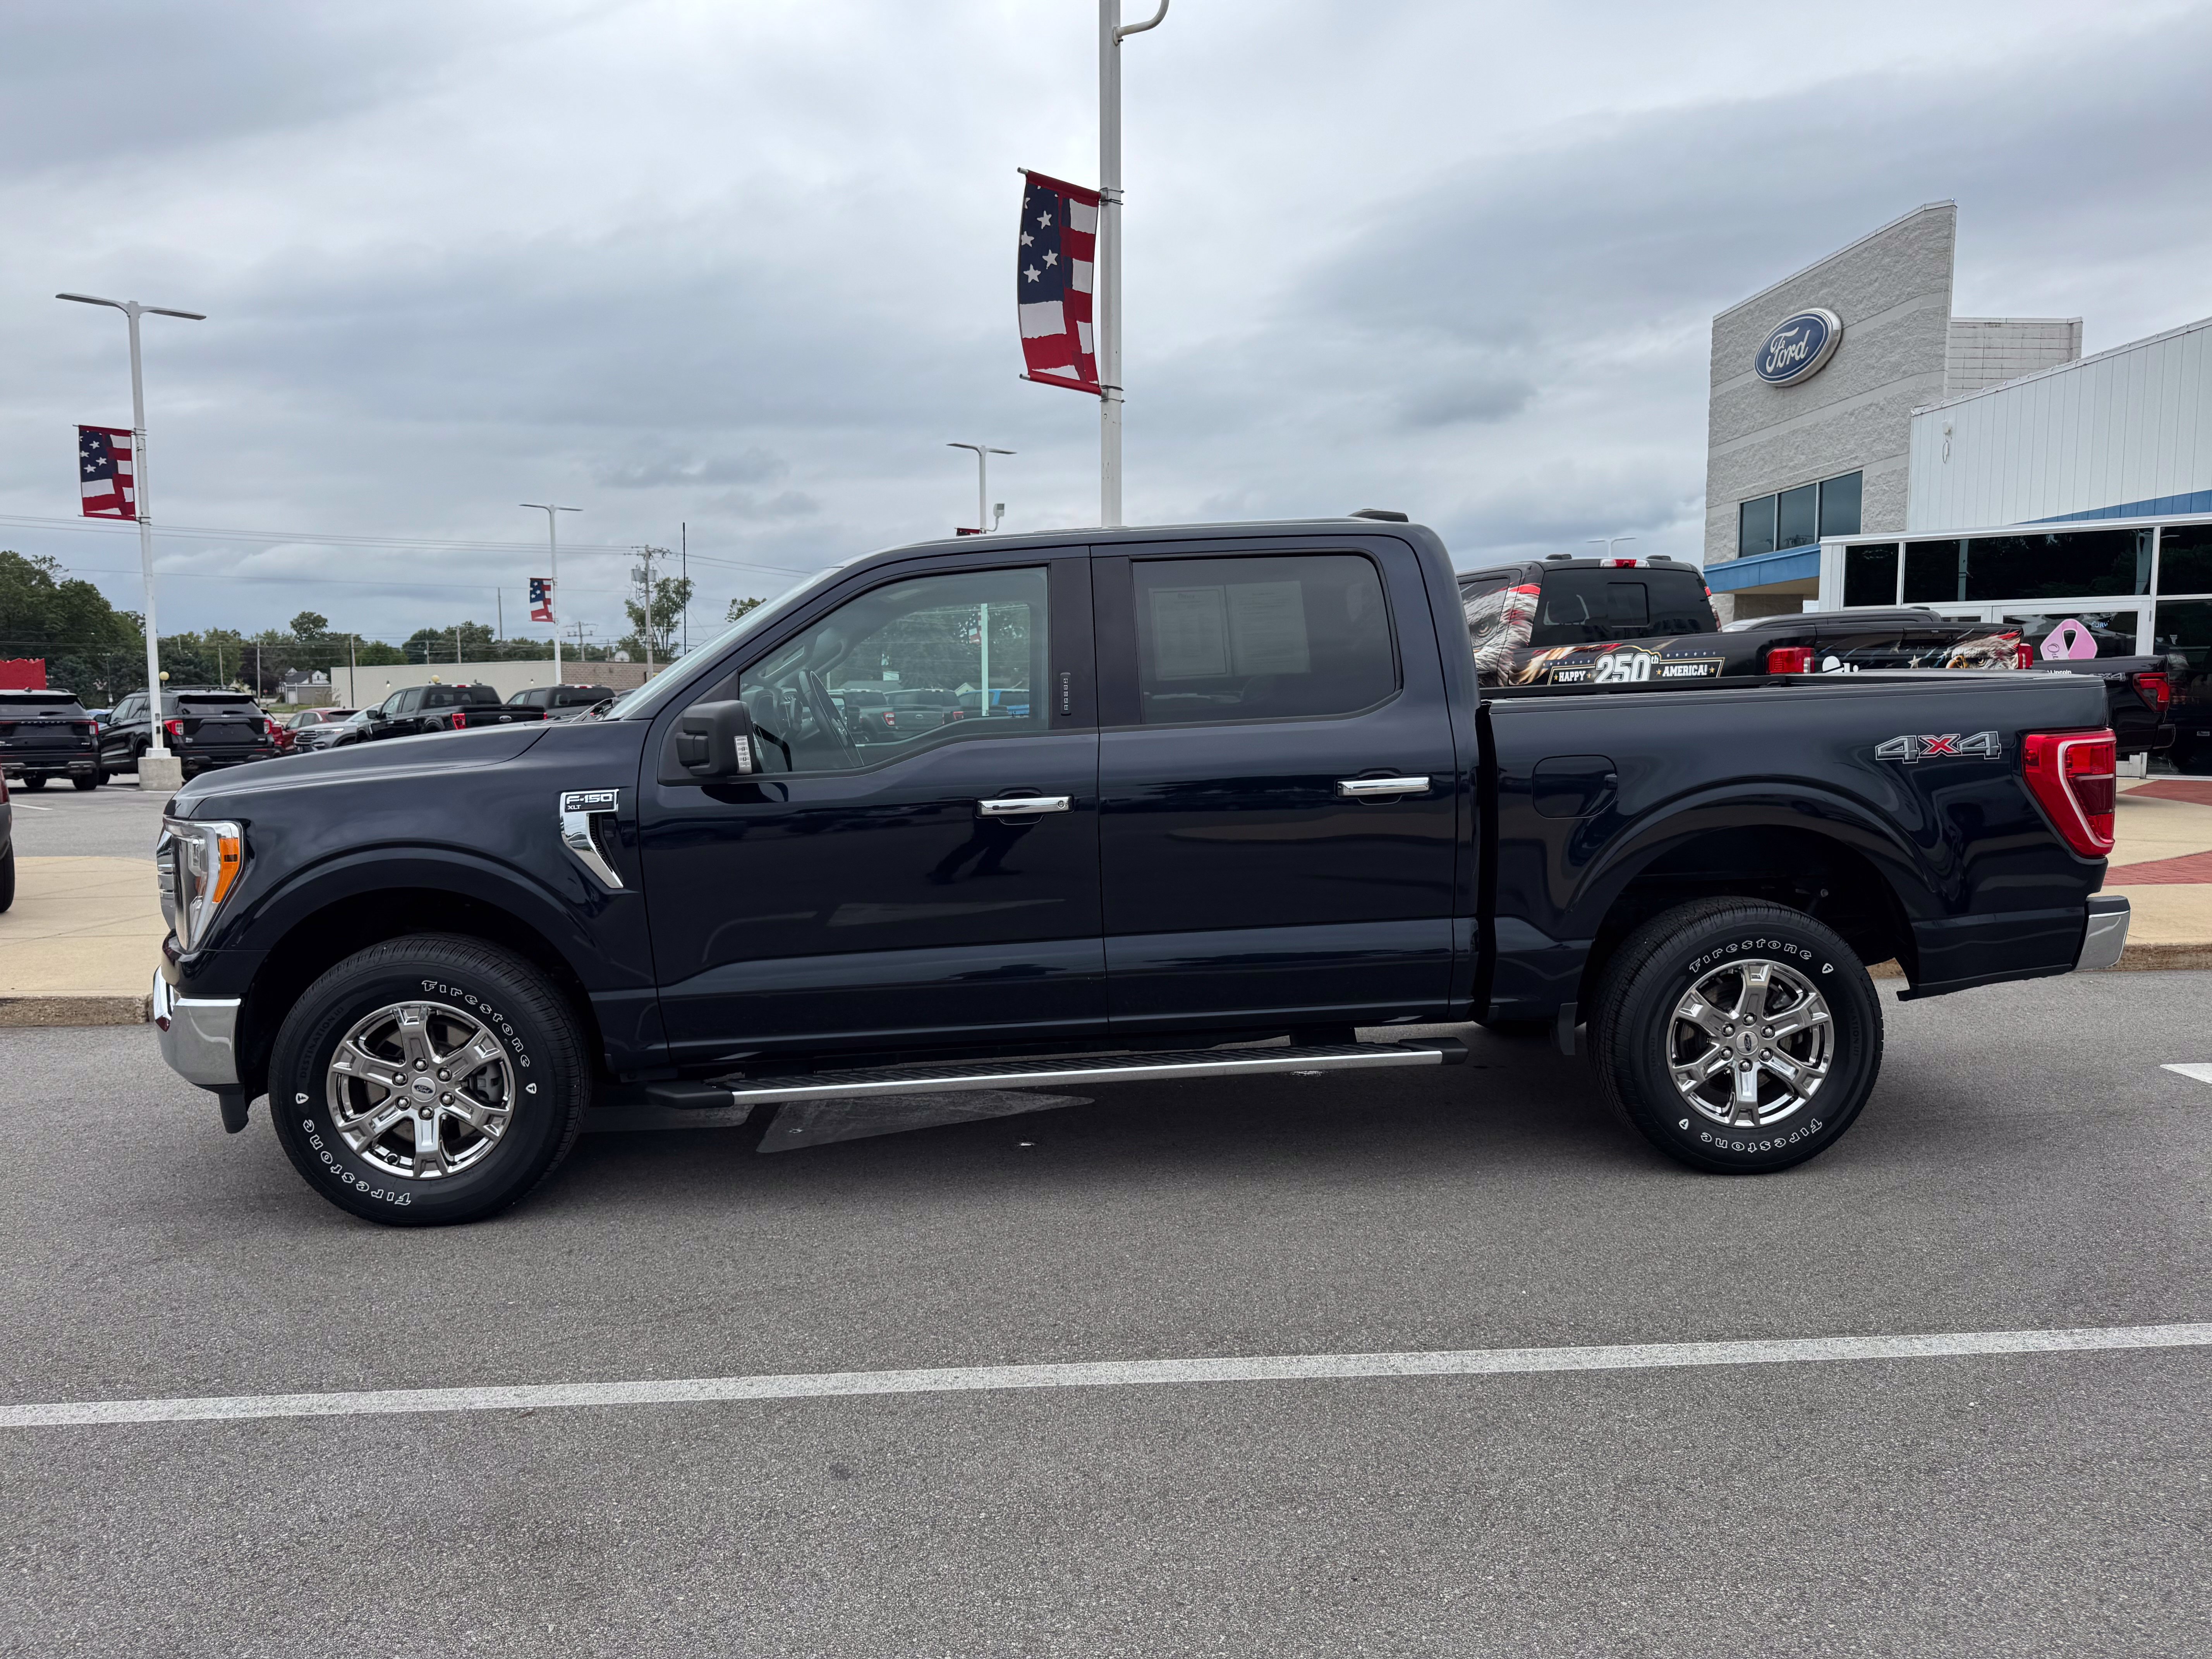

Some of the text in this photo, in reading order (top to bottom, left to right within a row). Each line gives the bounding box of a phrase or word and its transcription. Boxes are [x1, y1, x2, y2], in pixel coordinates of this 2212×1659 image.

[1766, 327, 1810, 373] Ford
[1558, 671, 1586, 682] HAPPY
[1662, 664, 1708, 677] AMERICA!
[566, 793, 613, 804] F-150
[1689, 938, 1812, 973] Firestone
[421, 980, 530, 1067] Firestone
[300, 1016, 336, 1079] DESTINATION
[1700, 1118, 1822, 1153] Firestone
[303, 1119, 411, 1206] Firestone
